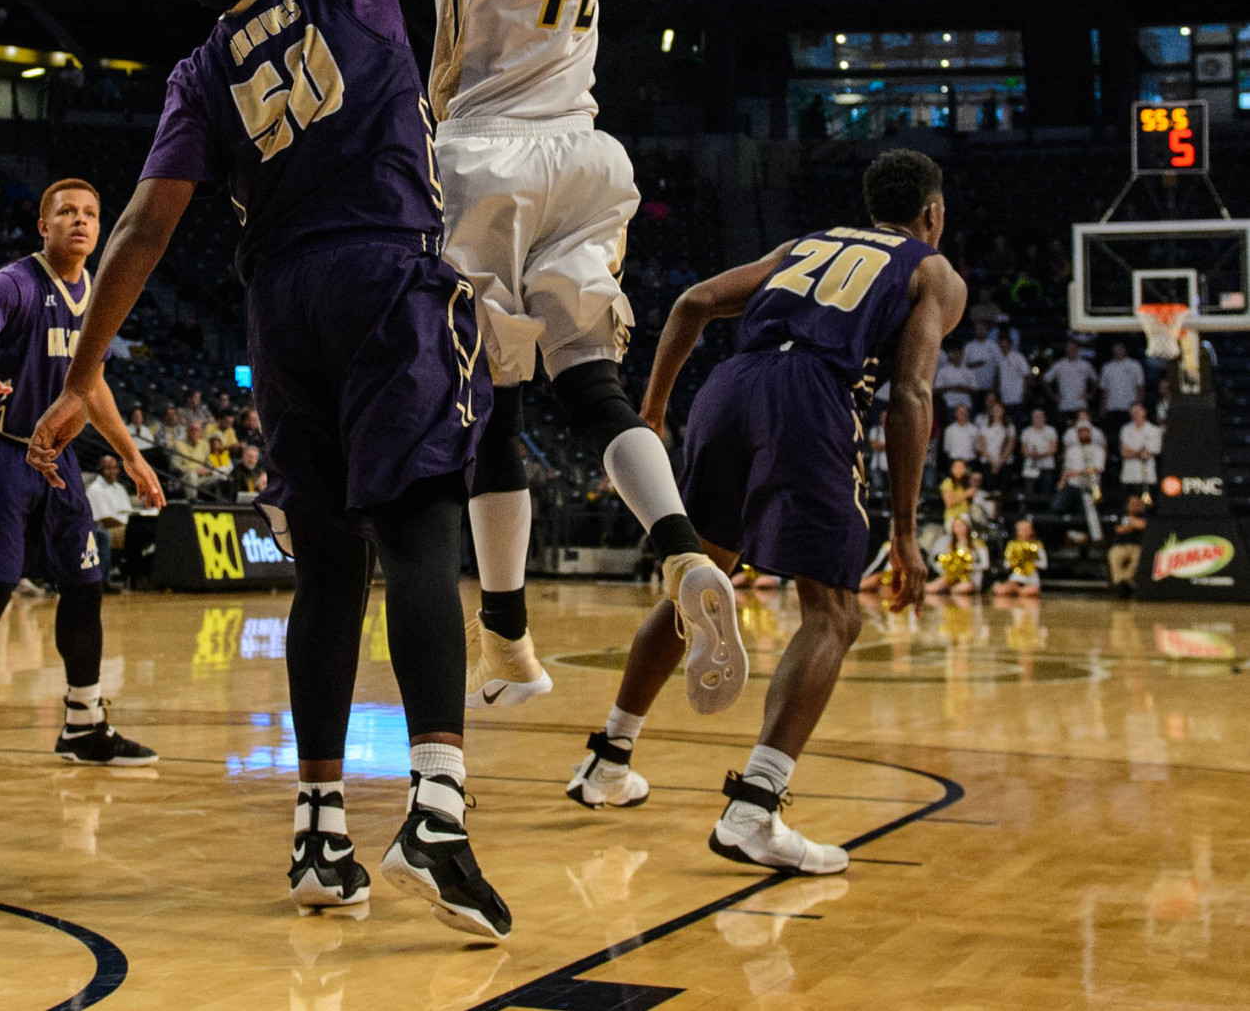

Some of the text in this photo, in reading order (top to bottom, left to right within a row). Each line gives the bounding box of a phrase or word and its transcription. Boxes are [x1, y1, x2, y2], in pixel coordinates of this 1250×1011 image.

[230, 23, 345, 163] 50
[1169, 128, 1195, 167] 5
[765, 238, 892, 313] 20
[1182, 476, 1223, 496] PNC
